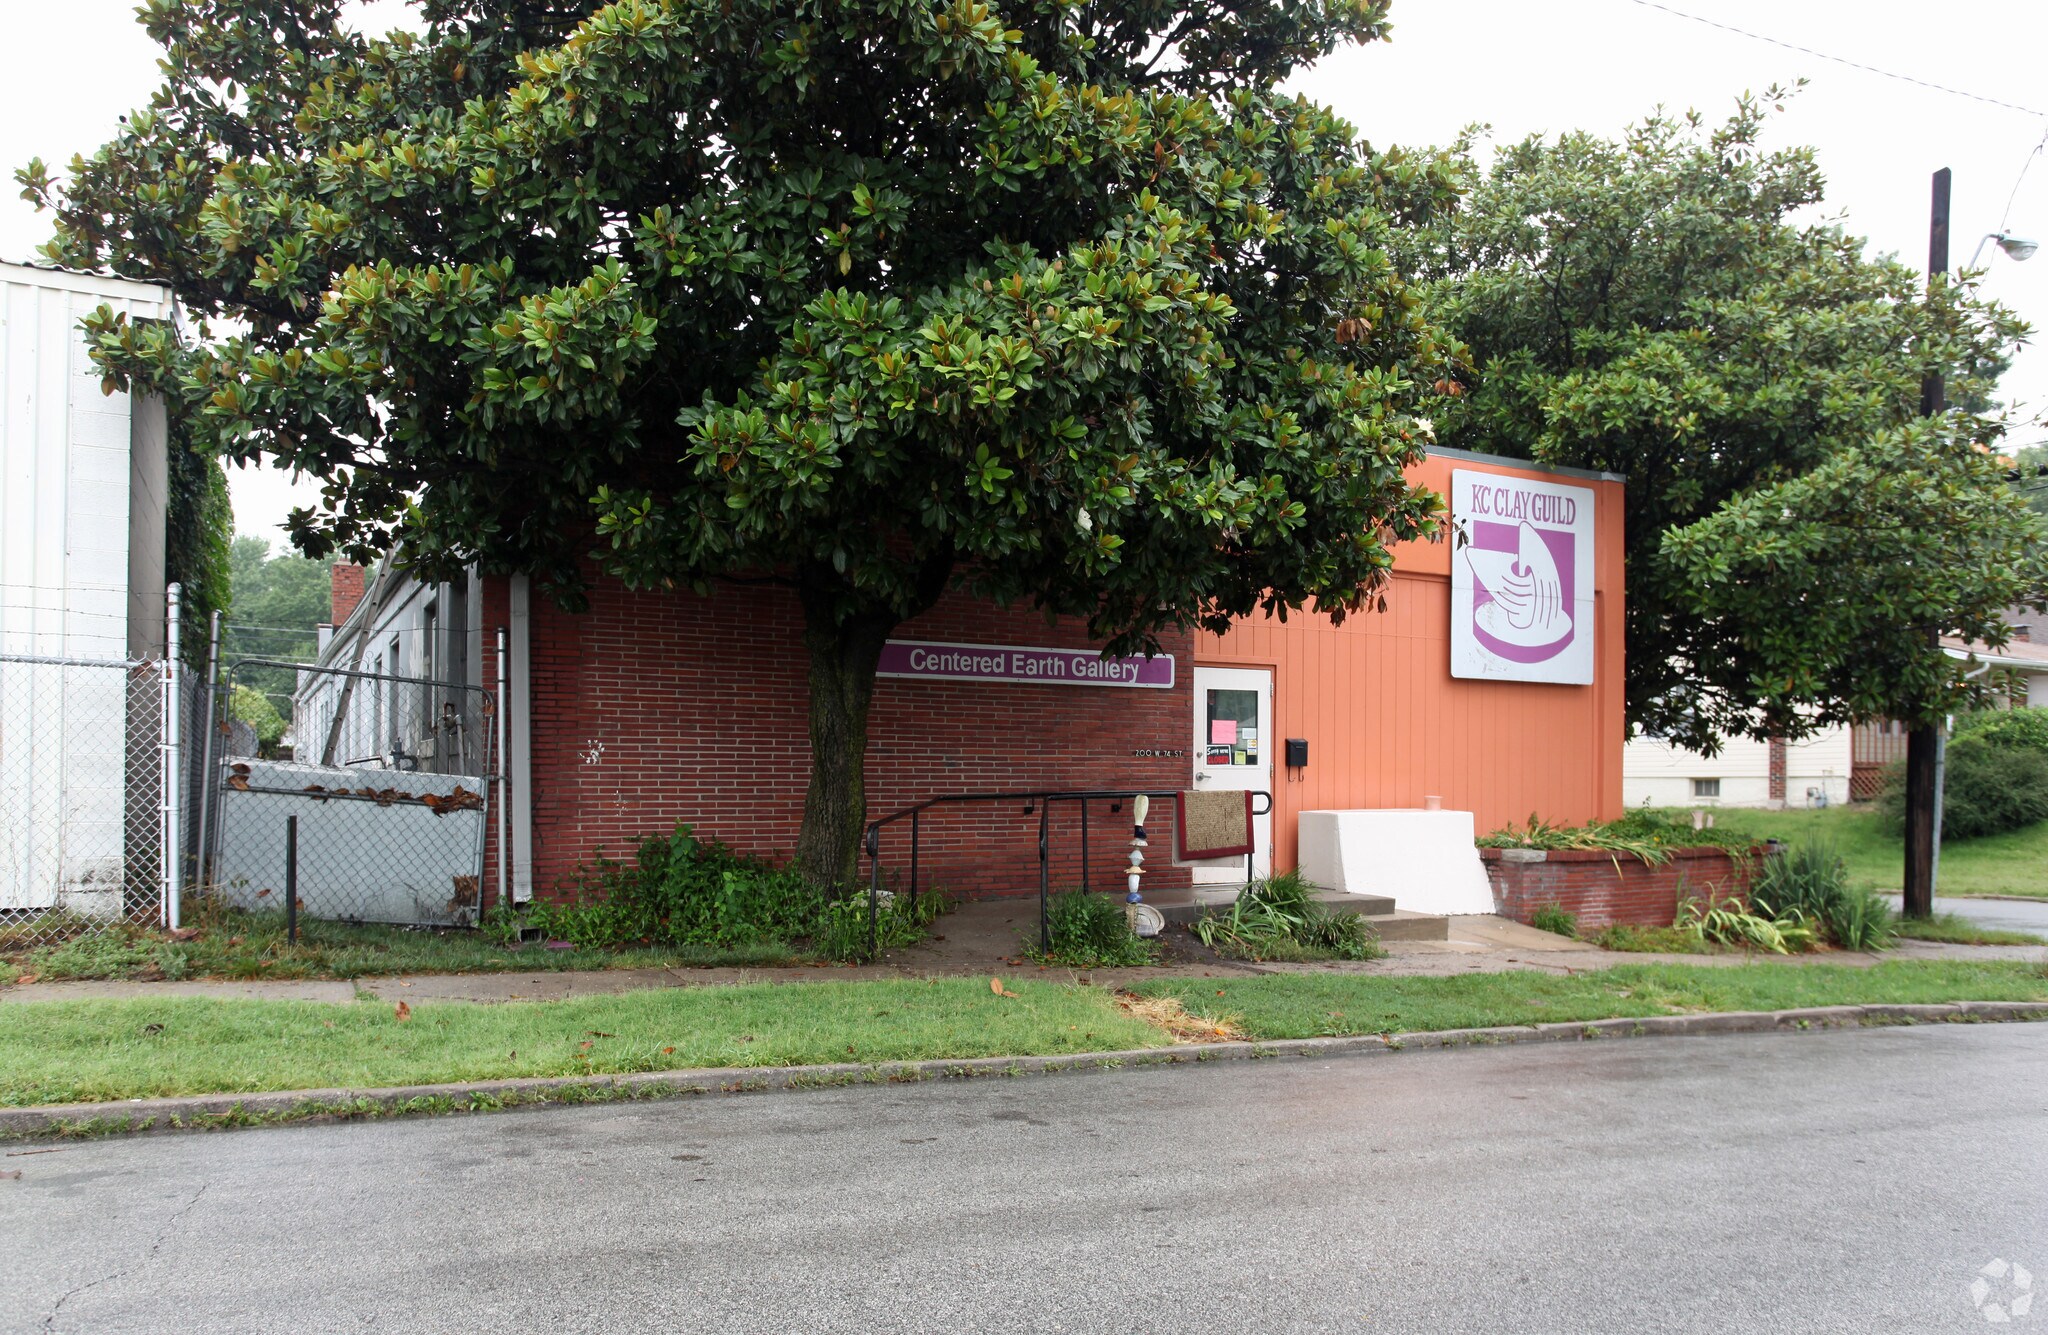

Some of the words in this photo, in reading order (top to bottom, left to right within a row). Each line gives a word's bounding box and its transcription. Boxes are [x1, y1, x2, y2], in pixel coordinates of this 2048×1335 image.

[1471, 483, 1491, 515] KC
[1494, 487, 1531, 520] CLAY
[1532, 493, 1576, 525] GUILD
[909, 648, 1005, 674] Centered
[1012, 653, 1066, 676] Earth
[1071, 656, 1140, 684] Gallery
[1135, 749, 1152, 757] 200
[1154, 750, 1161, 758] W
[1174, 750, 1183, 758] ST
